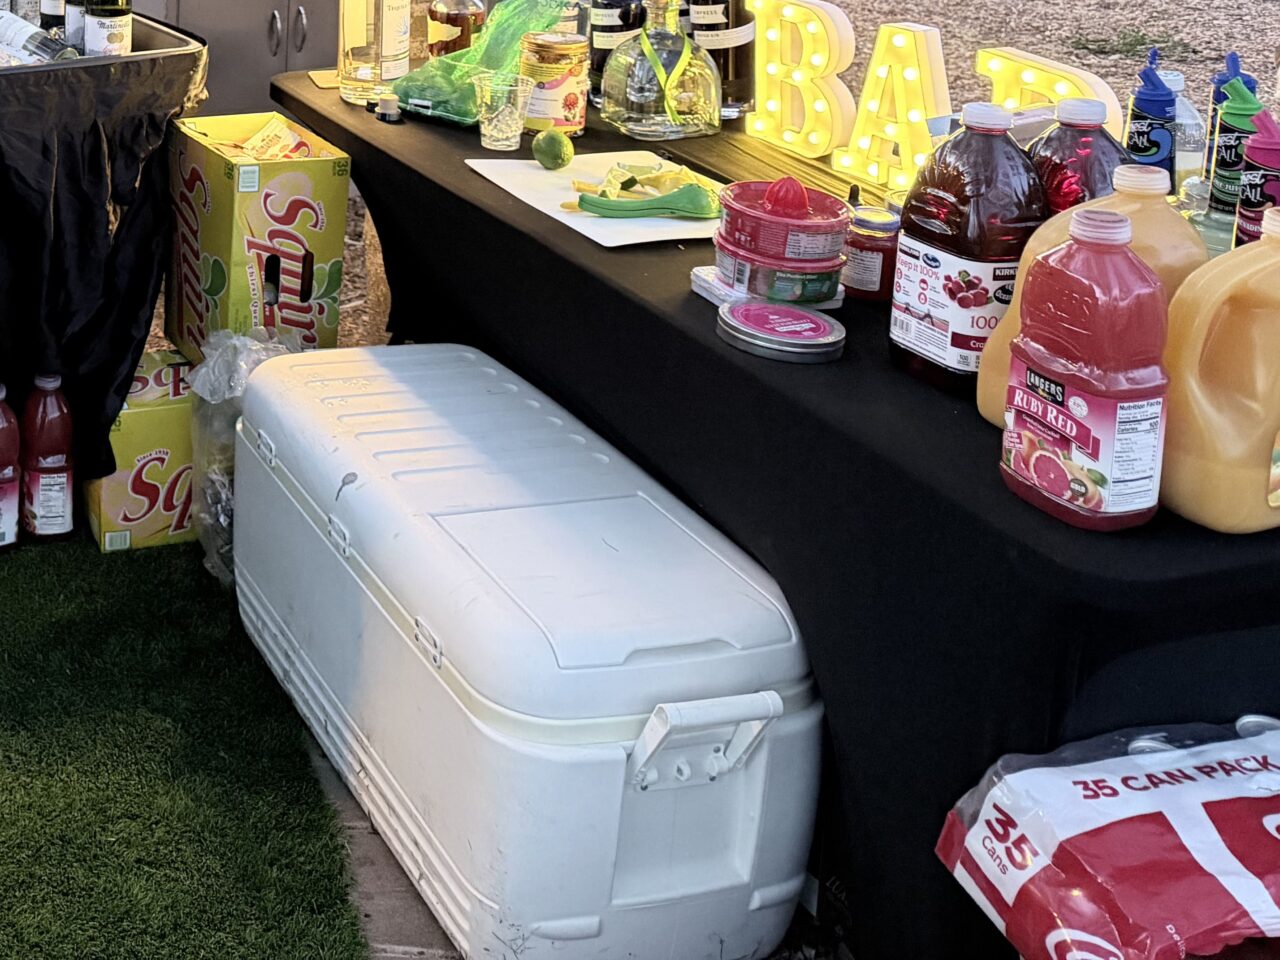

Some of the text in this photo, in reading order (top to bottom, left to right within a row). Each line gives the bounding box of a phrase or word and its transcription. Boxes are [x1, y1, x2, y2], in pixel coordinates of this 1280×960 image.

[337, 160, 349, 177] 36
[245, 189, 321, 349] Squir
[919, 264, 940, 281] 100%
[248, 265, 259, 327] Thirst Quen
[970, 315, 1000, 330] 100
[1026, 370, 1063, 402] LANGERS
[1013, 389, 1045, 419] RUBY
[1046, 405, 1078, 437] RED
[1071, 754, 1280, 801] 35 CAN PACK
[980, 835, 1010, 876] Cans
[984, 801, 1041, 872] 35
